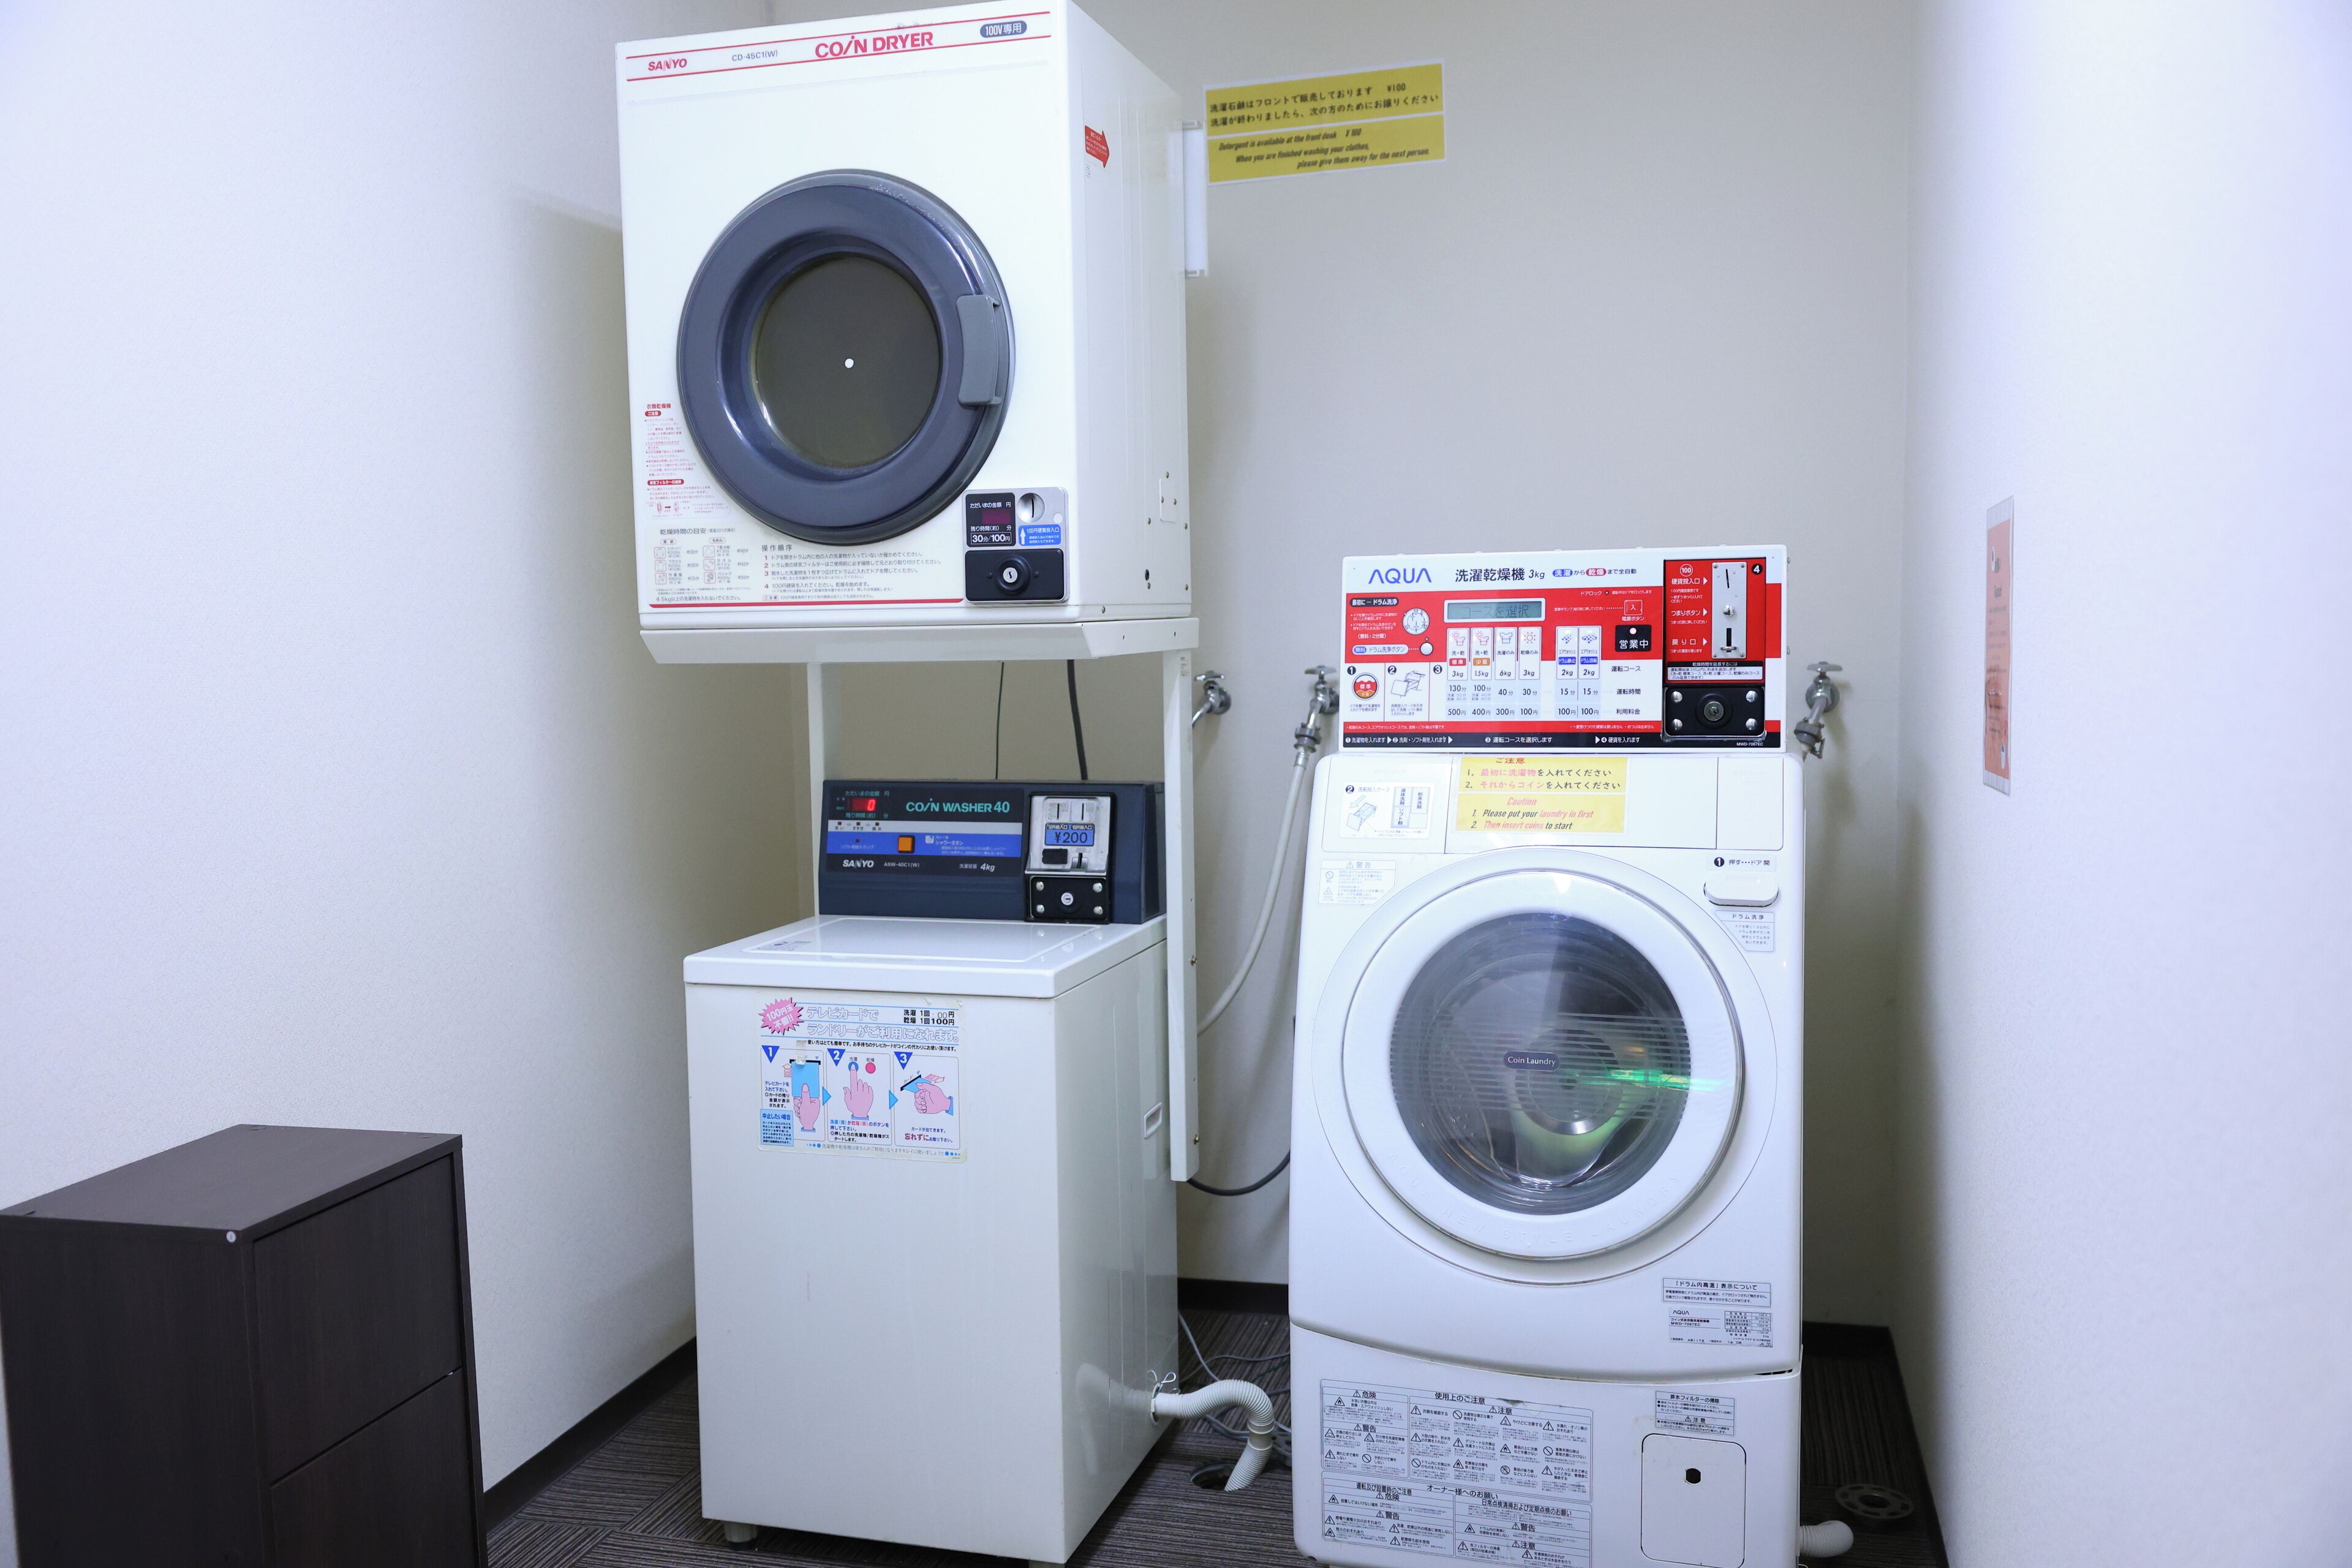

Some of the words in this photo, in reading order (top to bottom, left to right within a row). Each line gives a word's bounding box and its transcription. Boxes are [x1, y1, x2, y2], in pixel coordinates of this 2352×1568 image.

[985, 23, 1022, 36] 100V専用
[873, 31, 933, 51] DRYER
[648, 58, 687, 70] SANYO
[1387, 83, 1406, 92] ¥100
[1219, 140, 1248, 151] Detergent
[1257, 135, 1284, 146] available
[1294, 134, 1303, 143] the
[1305, 132, 1321, 141] front
[1236, 153, 1252, 162] When
[1253, 153, 1265, 162] you
[1278, 147, 1302, 158] finished
[1303, 145, 1329, 157] washing
[1330, 145, 1344, 154] your
[1297, 159, 1318, 168] please
[1319, 158, 1332, 168] give
[1333, 156, 1349, 164] them
[1351, 154, 1366, 164] away
[1368, 568, 1431, 584] AQUA
[1455, 568, 1525, 582] 洗濯乾燥機
[1529, 570, 1545, 579] 3kg
[1461, 605, 1529, 619] コースを選択
[1619, 639, 1648, 649] 営業中
[867, 799, 875, 812] 0
[943, 803, 992, 813] WASHER
[993, 802, 1010, 813] 40
[1507, 810, 1519, 818] put
[1539, 810, 1567, 818] laundry
[1055, 832, 1088, 843] ¥200
[843, 859, 874, 868] SANYO
[981, 863, 995, 872] 4kg
[767, 1005, 793, 1022] 100円玉
[806, 1007, 878, 1020] テレビカードで
[807, 1023, 959, 1042] ランドリーがご利用になれます。
[767, 1048, 774, 1057] 1
[834, 1050, 840, 1060] 2
[900, 1054, 907, 1063] 3
[1527, 1057, 1556, 1066] Laundry
[1435, 1392, 1485, 1404] 使用上のご注意
[1385, 1493, 1400, 1501] 危険
[1427, 1485, 1498, 1499] オーナー様へのお願い
[1385, 1511, 1400, 1520] 警告
[1520, 1523, 1536, 1532] 警告
